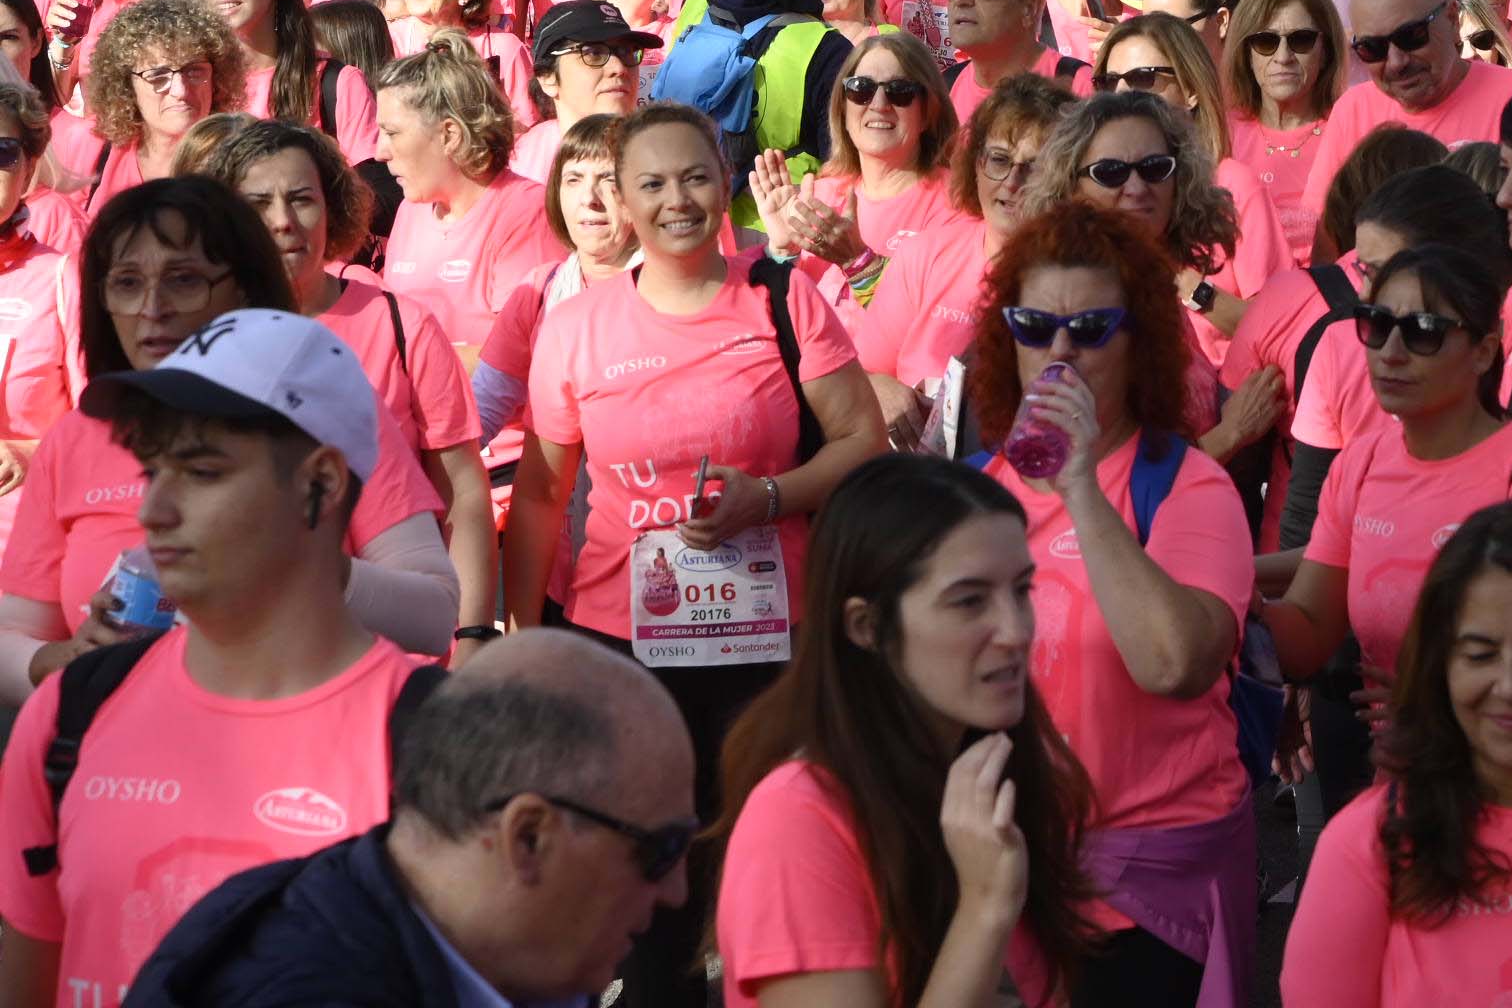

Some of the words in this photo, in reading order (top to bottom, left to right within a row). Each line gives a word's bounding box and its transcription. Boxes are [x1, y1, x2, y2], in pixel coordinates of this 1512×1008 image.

[605, 355, 667, 380] OYSHO
[609, 458, 657, 489] TU
[680, 552, 738, 566] ASTURIANA
[684, 582, 737, 603] 016
[690, 608, 732, 622] 20176
[652, 628, 694, 637] CARRERA
[695, 627, 708, 635] DE
[710, 626, 721, 634] LA
[723, 625, 753, 634] MUJER
[755, 623, 776, 631] 2023
[649, 646, 695, 658] OYSHO
[733, 642, 780, 654] Santander
[84, 775, 181, 804] OYSHO
